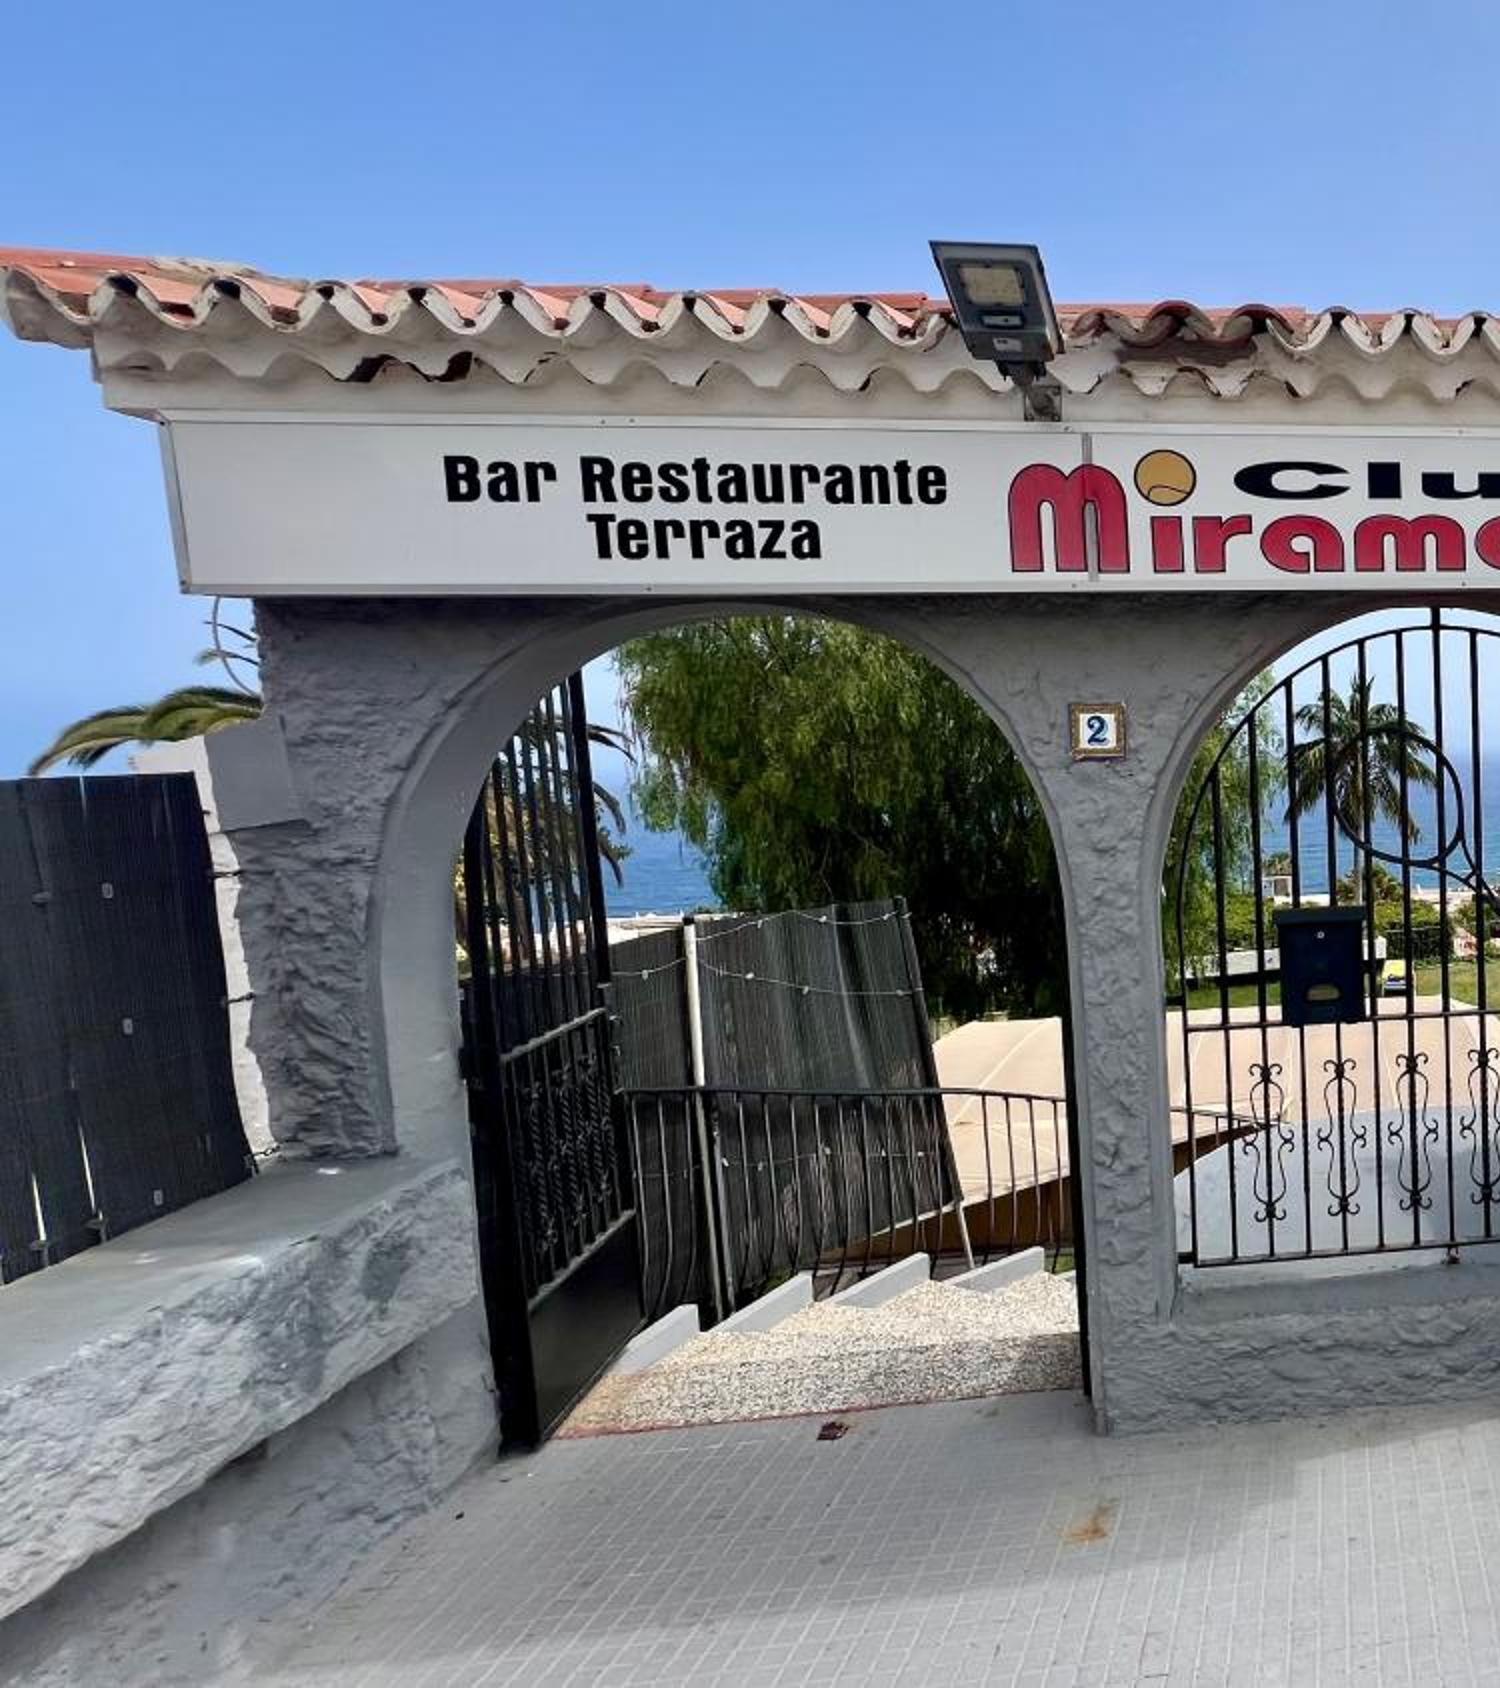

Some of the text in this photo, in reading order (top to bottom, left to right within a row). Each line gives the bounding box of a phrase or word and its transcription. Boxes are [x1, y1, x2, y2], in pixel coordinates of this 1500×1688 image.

[443, 455, 948, 505] Bar Restaurante
[586, 513, 823, 561] Terraza
[1087, 715, 1108, 745] 2
